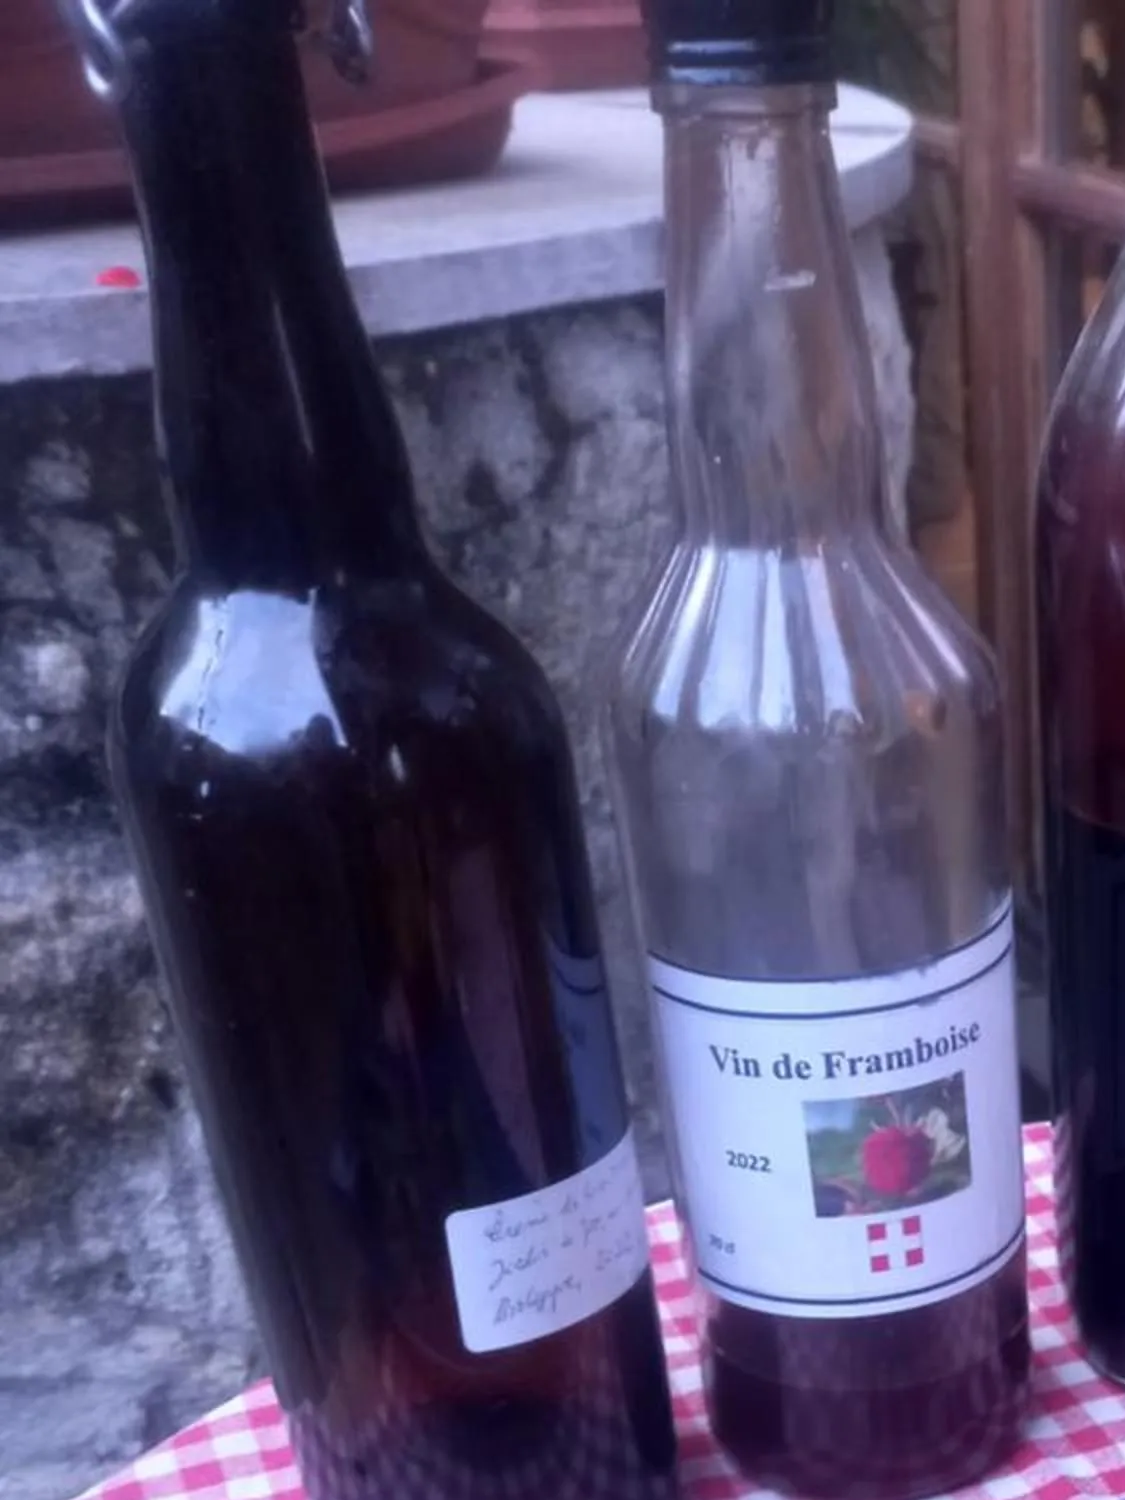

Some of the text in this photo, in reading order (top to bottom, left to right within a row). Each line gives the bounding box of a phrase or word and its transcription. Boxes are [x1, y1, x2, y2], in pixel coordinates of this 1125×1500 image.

[708, 1021, 981, 1081] Vin de Framboise
[725, 1149, 772, 1173] 2022
